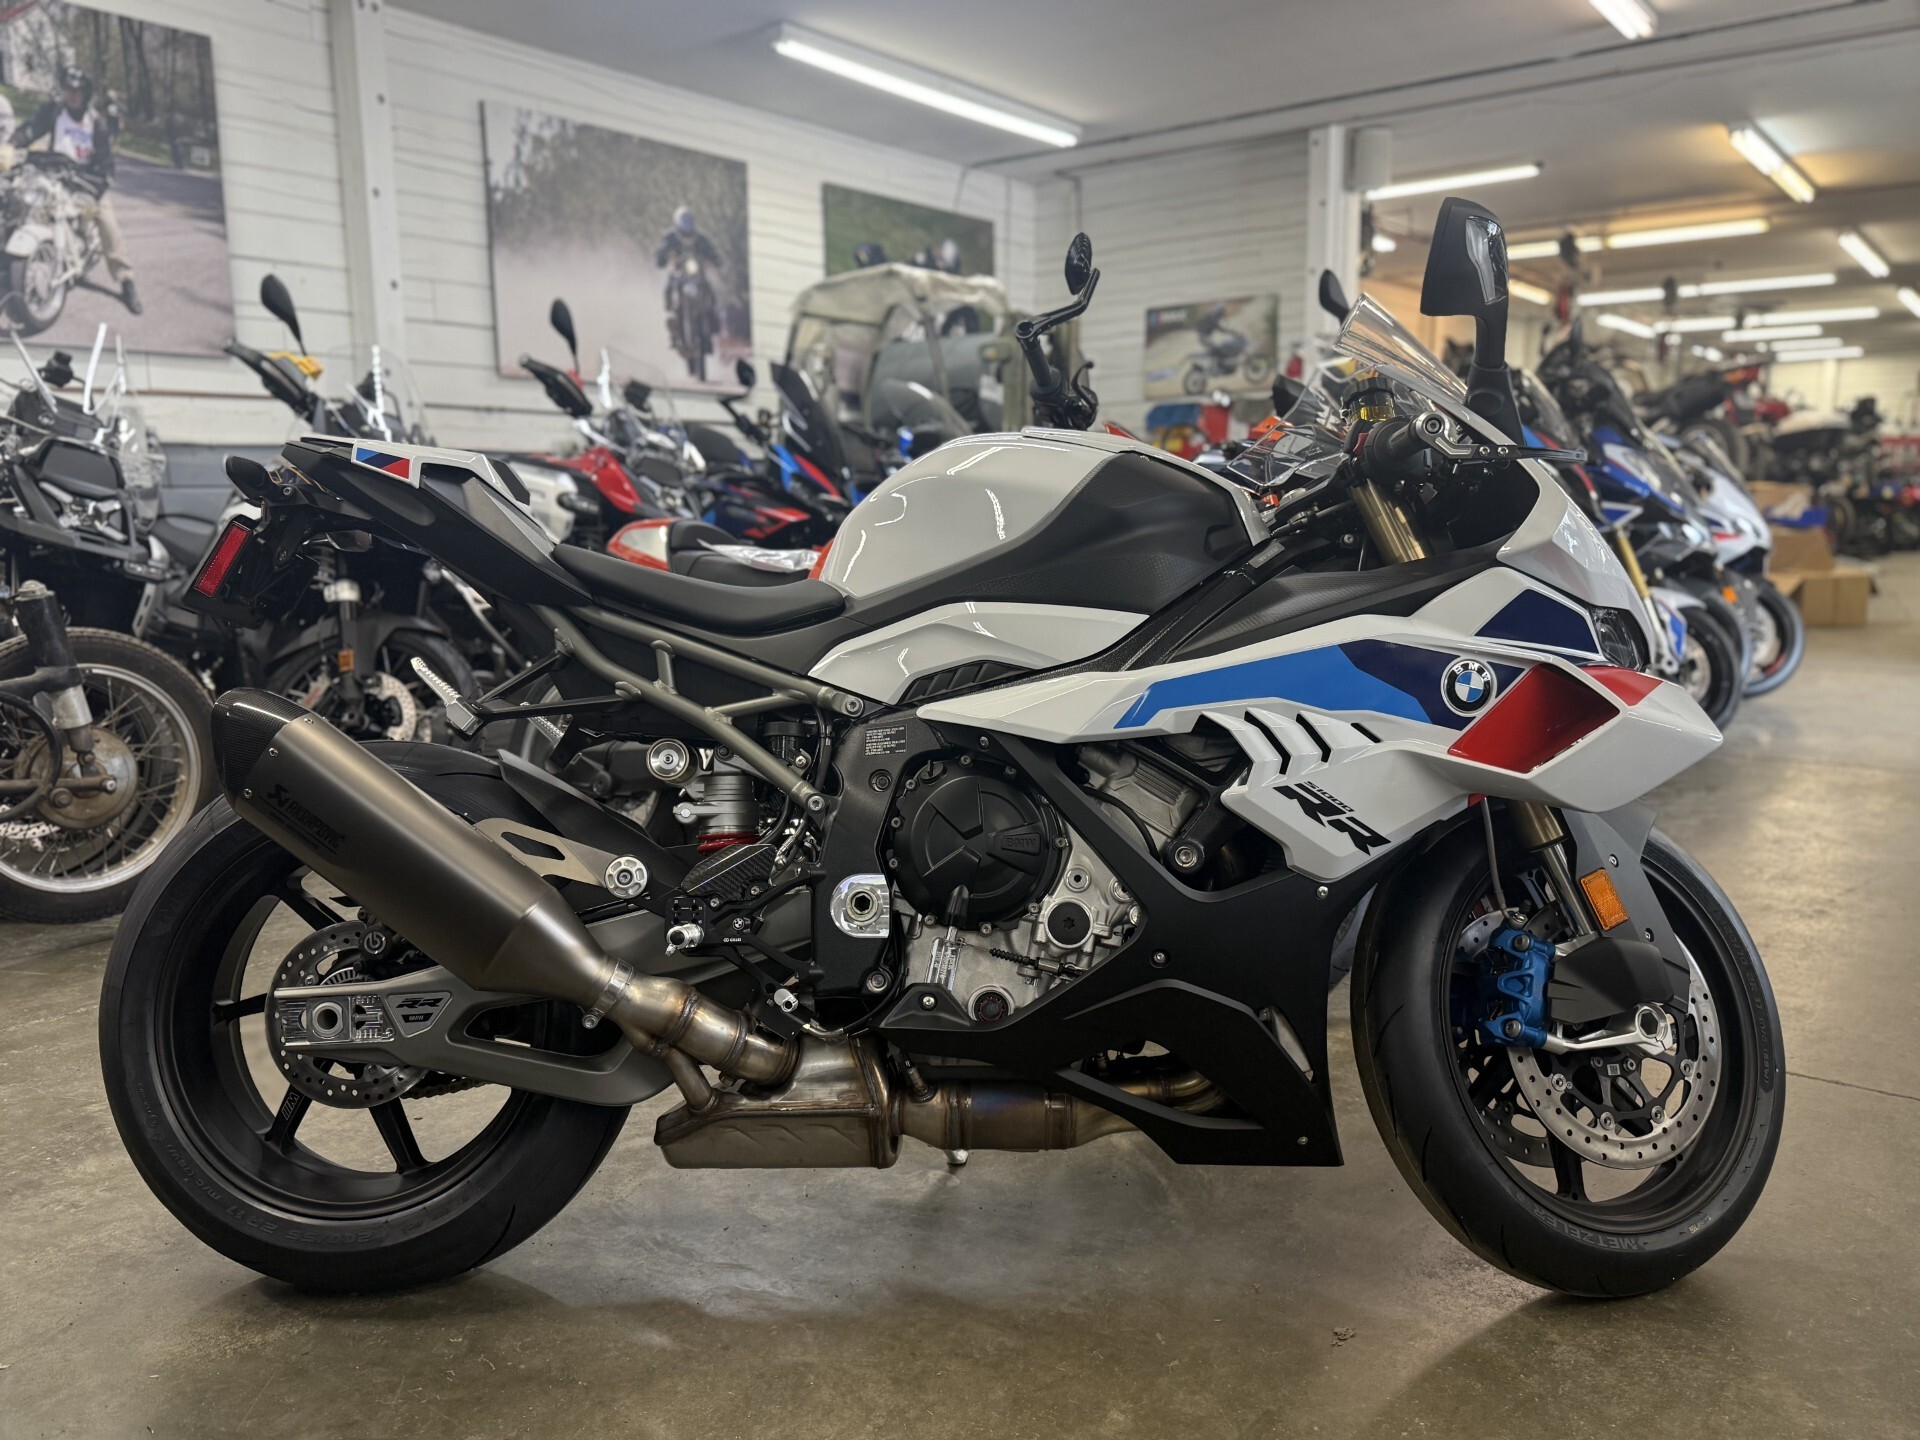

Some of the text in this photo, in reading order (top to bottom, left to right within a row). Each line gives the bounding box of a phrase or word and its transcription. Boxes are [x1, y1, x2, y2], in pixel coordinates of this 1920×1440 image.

[1272, 783, 1391, 856] RR
[1006, 837, 1037, 848] BMW
[395, 997, 444, 1008] RR
[1534, 1206, 1638, 1250] METZELER
